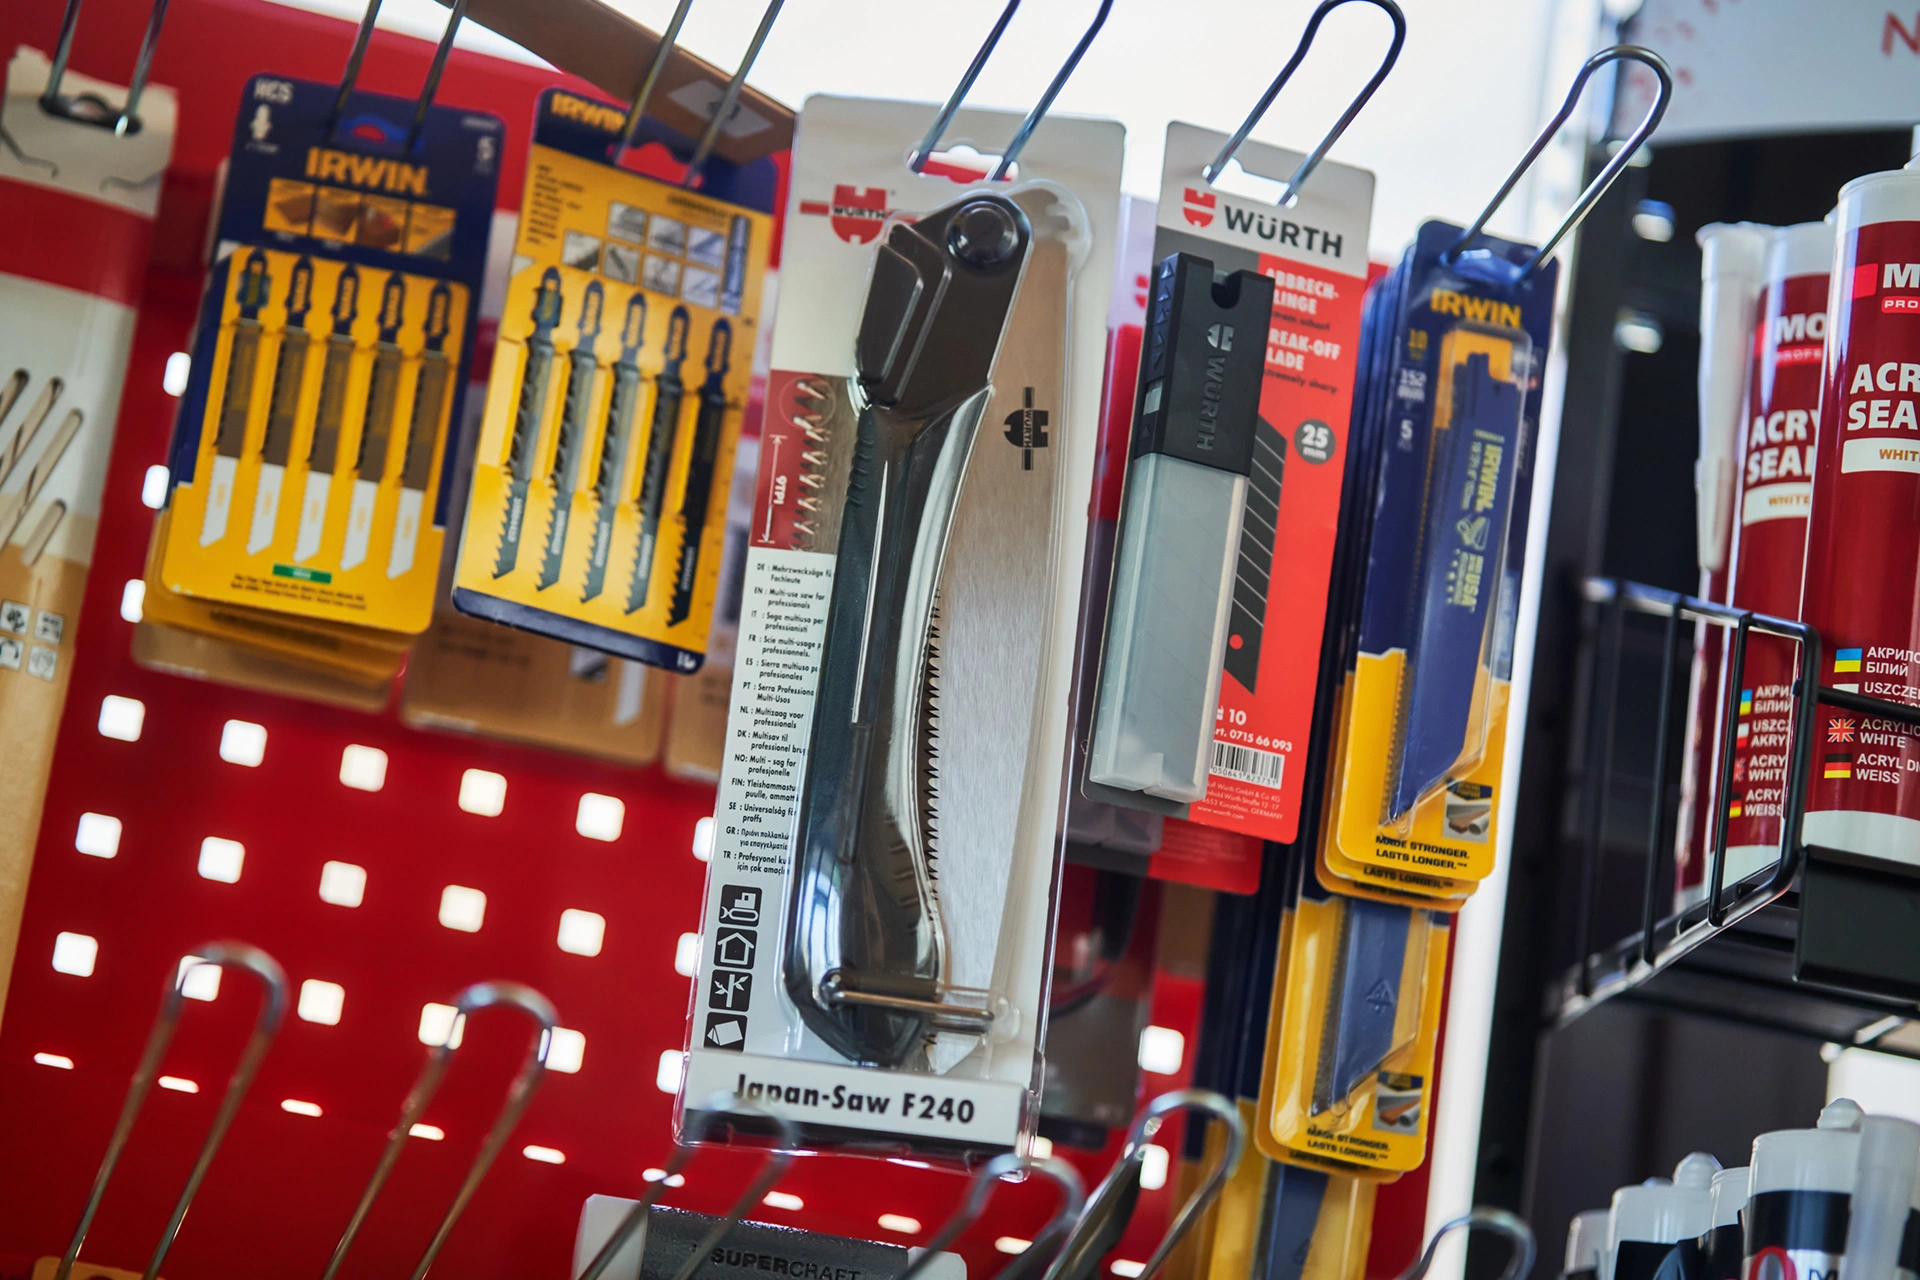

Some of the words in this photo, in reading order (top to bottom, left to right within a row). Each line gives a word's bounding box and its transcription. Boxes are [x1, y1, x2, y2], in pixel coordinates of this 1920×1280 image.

[304, 145, 430, 196] IRWIN
[1883, 263, 1920, 288] M
[1273, 289, 1317, 315] LINGE
[1430, 287, 1522, 328] IRWIN
[1884, 300, 1919, 309] PRO
[1775, 312, 1827, 344] MO
[1269, 328, 1341, 360] REAK-OFF
[1266, 347, 1305, 371] LADE
[1850, 362, 1920, 395] ACR
[1847, 399, 1919, 431] SEA
[1400, 418, 1414, 439] 5
[1750, 409, 1819, 449] ACRY
[1302, 423, 1329, 449] 25
[1302, 447, 1327, 460] mm
[1879, 449, 1920, 462] WHIT
[773, 475, 787, 505] 9TPI
[769, 589, 798, 598] Multi-use
[815, 592, 825, 600] for
[768, 599, 811, 609] professionals
[766, 611, 782, 622] Sega
[784, 614, 811, 623] multiuso
[765, 623, 808, 633] professionisti
[763, 635, 777, 644] Scie
[778, 637, 816, 650] multi-usage
[1867, 646, 1920, 664] АКРИЛО
[746, 657, 753, 666] ES
[761, 659, 780, 669] Sierra
[782, 661, 809, 671] multiuso
[1866, 661, 1909, 677] БІЛИЙ
[759, 670, 803, 681] profesionales
[743, 681, 751, 689] PT
[758, 683, 775, 692] Serra
[777, 685, 814, 696] Professiona
[1756, 685, 1791, 698] АКРИ
[1864, 681, 1920, 700] USZCZE
[756, 693, 790, 704] Multi-Usos
[740, 706, 749, 714] NL
[755, 707, 787, 720] Multizaag
[1229, 708, 1247, 726] 10
[753, 718, 797, 729] professionals
[1752, 719, 1790, 733] USZC
[737, 729, 746, 738] DK
[752, 731, 780, 741] Multisav
[1215, 728, 1227, 737] rt.
[1229, 729, 1254, 743] 0715
[1255, 735, 1270, 747] 66
[1272, 739, 1293, 752] 093
[1751, 734, 1786, 748] AKRY
[1859, 732, 1906, 749] WHITE
[751, 742, 791, 753] professionel
[749, 754, 766, 764] Multi
[786, 758, 796, 767] for
[1749, 755, 1786, 768] ACRY
[1857, 753, 1904, 769] ACRYL
[1907, 760, 1920, 772] DI
[748, 766, 791, 777] profesjonelle
[1856, 769, 1901, 785] WEISS
[731, 778, 745, 787] FIN:
[747, 779, 796, 792] Yleishammastu
[745, 790, 768, 800] puulle,
[1746, 789, 1781, 802] ACRY
[729, 802, 736, 810] SE
[742, 814, 762, 823] proffs
[726, 826, 736, 834] GR
[760, 831, 789, 841] πολλαπλώ
[750, 840, 788, 851] επαγγελματίε
[723, 850, 731, 859] TR
[738, 852, 777, 865] Profesyonel
[1376, 849, 1410, 862] LASTS
[750, 863, 761, 873] çok
[735, 1072, 891, 1115] Japan-Saw
[902, 1092, 975, 1124] F240
